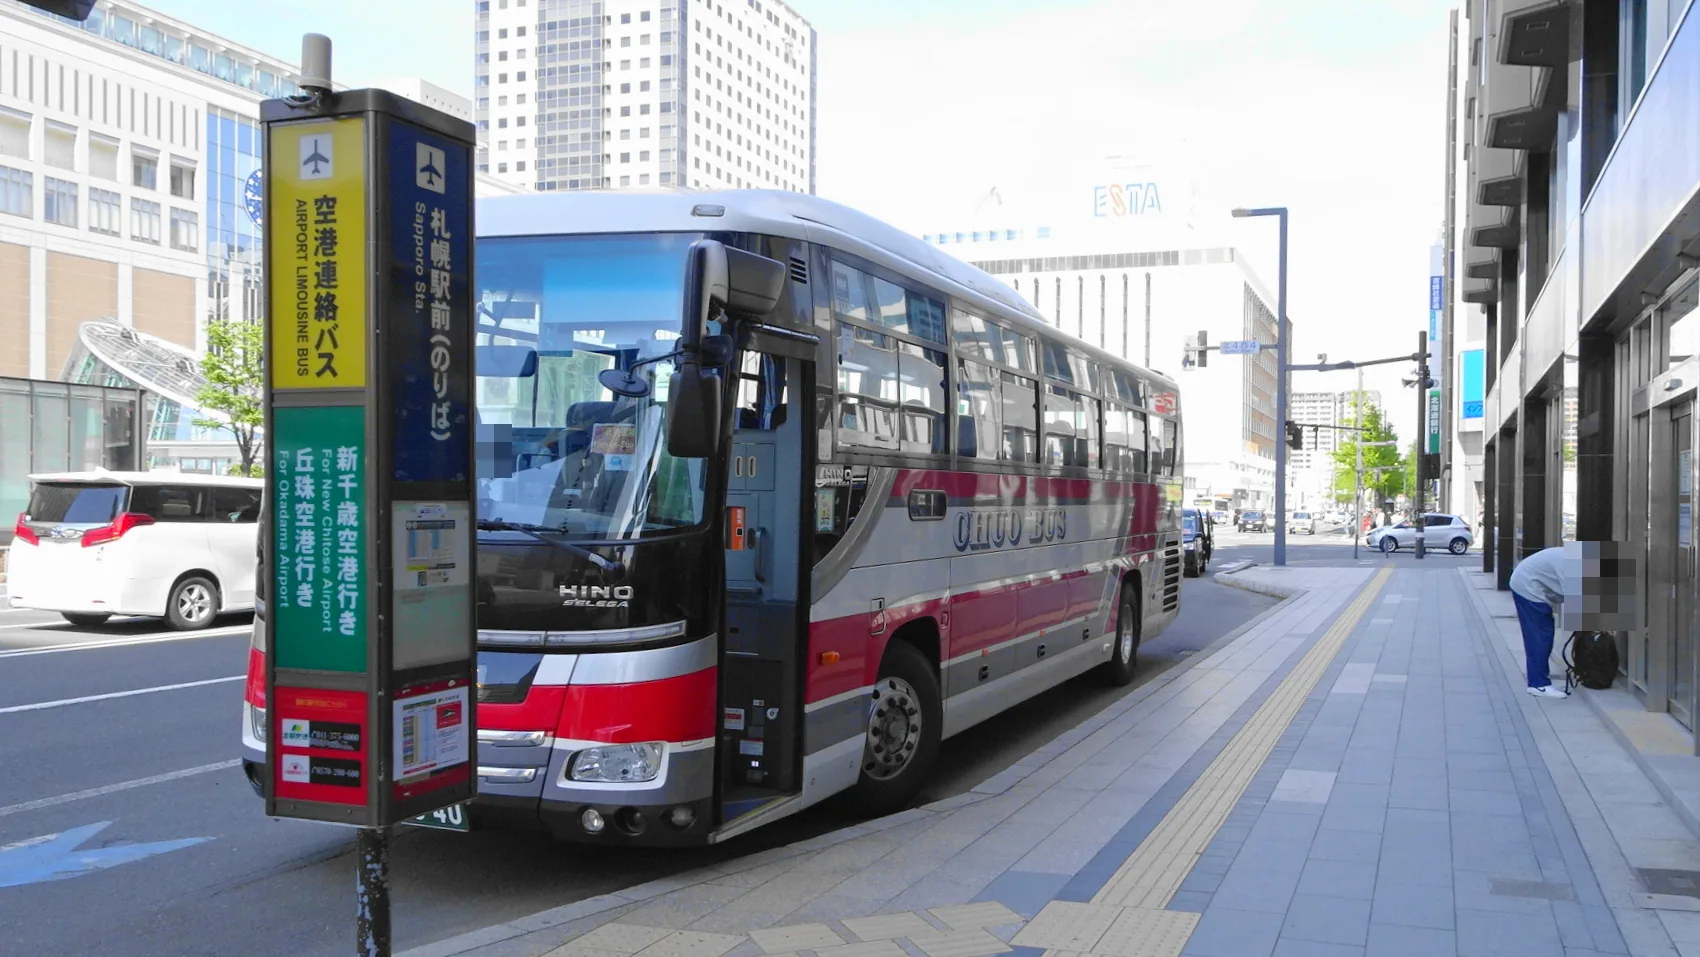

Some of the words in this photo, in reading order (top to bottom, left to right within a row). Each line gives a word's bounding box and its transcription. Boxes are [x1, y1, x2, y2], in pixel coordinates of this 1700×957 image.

[1094, 182, 1161, 217] ESTA
[296, 199, 308, 261] AIRPORT
[413, 201, 426, 276] Sapporo
[296, 266, 309, 344] LIMOUSINE
[313, 194, 339, 378] 空港連絡バス
[415, 280, 426, 313] Sta.
[297, 348, 309, 377] BUS
[279, 450, 289, 475] For
[322, 449, 332, 475] For
[279, 480, 290, 550] Okadama
[322, 479, 332, 512] New
[294, 447, 316, 608] 丘珠空港行き
[322, 516, 333, 574] Chitose
[336, 445, 359, 636] 新千歳空港行き
[952, 509, 1022, 552] CHUO
[1028, 507, 1067, 545] BUS
[277, 554, 290, 607] Airport
[320, 578, 333, 632] Airport
[559, 585, 634, 600] HINO
